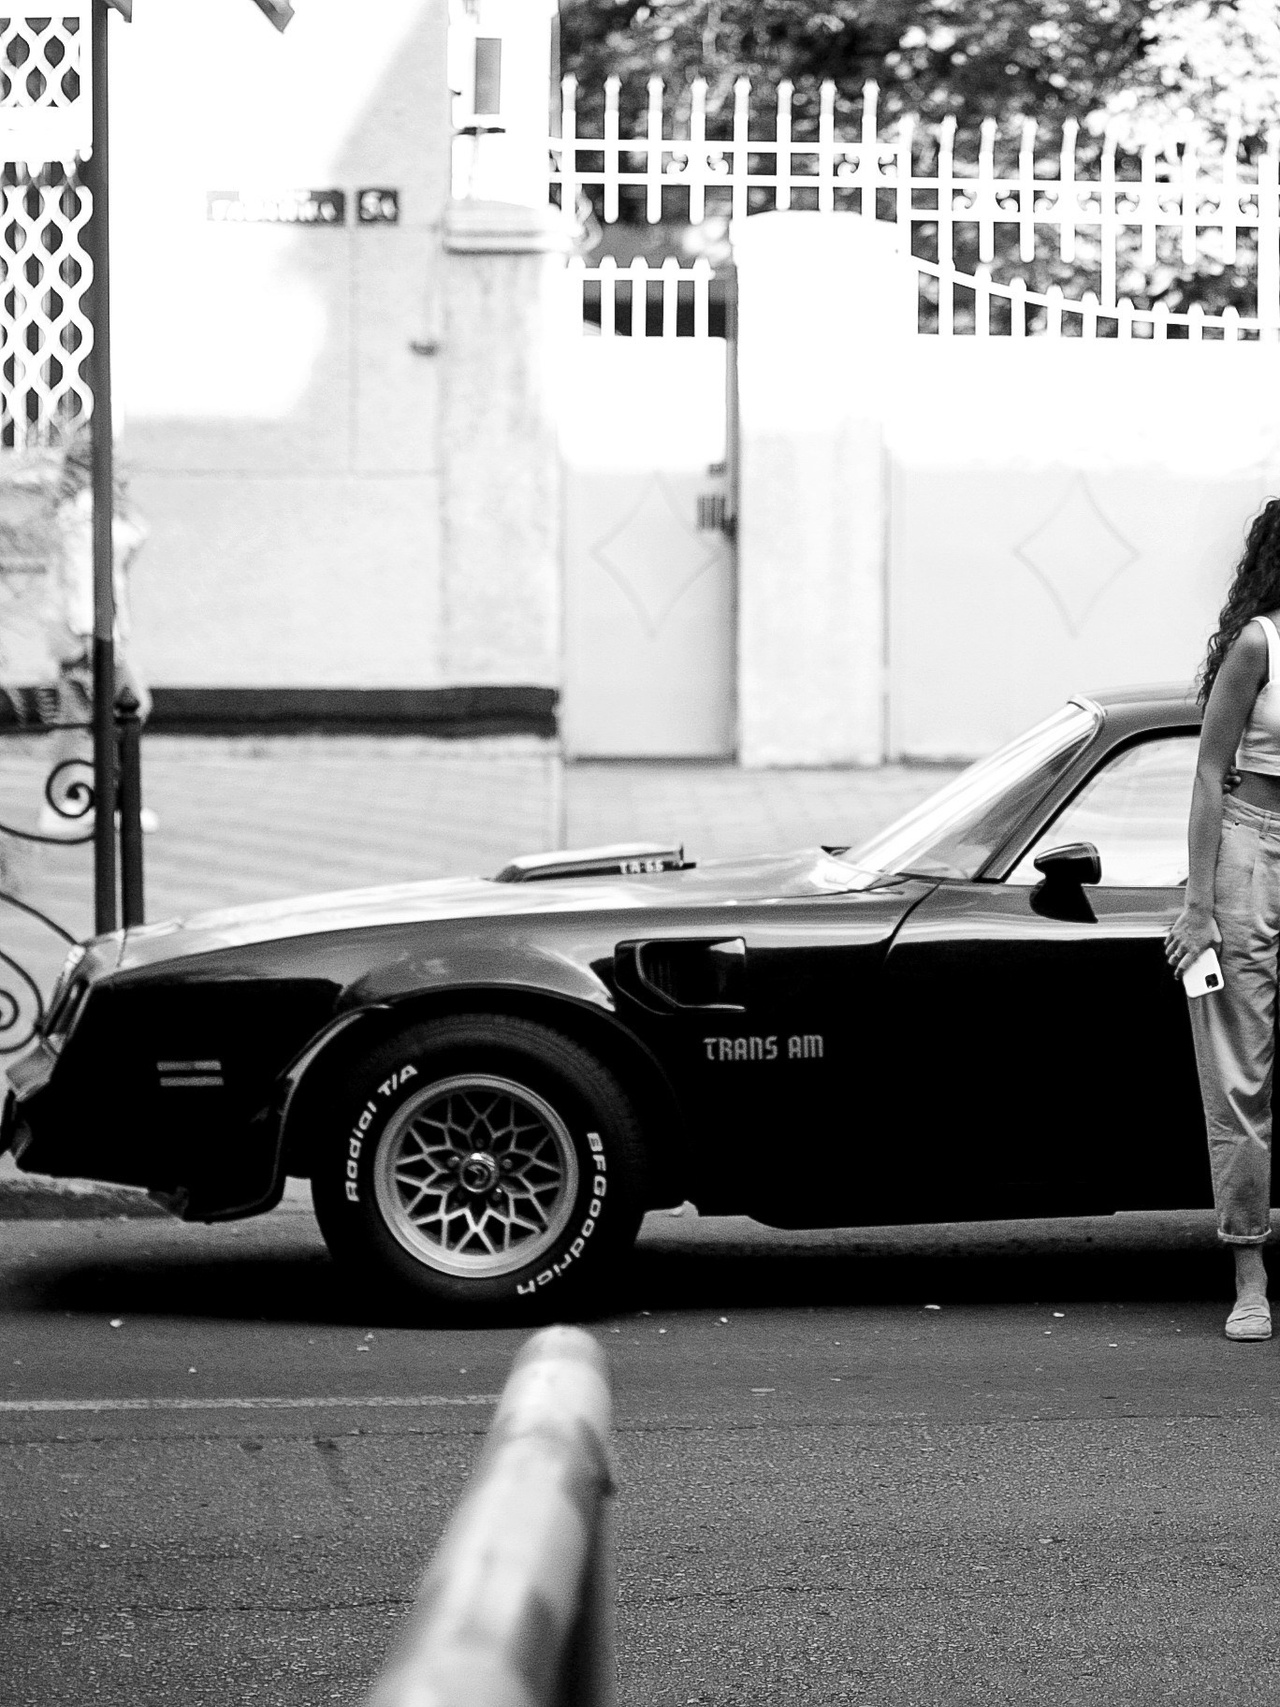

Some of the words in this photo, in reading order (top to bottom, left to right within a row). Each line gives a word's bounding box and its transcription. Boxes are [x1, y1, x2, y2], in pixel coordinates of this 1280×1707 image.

[704, 1036, 778, 1060] TRANS
[788, 1035, 823, 1058] AM
[345, 1101, 377, 1201] Radial
[377, 1064, 418, 1096] T/A
[516, 1132, 607, 1295] BFGoodrich
